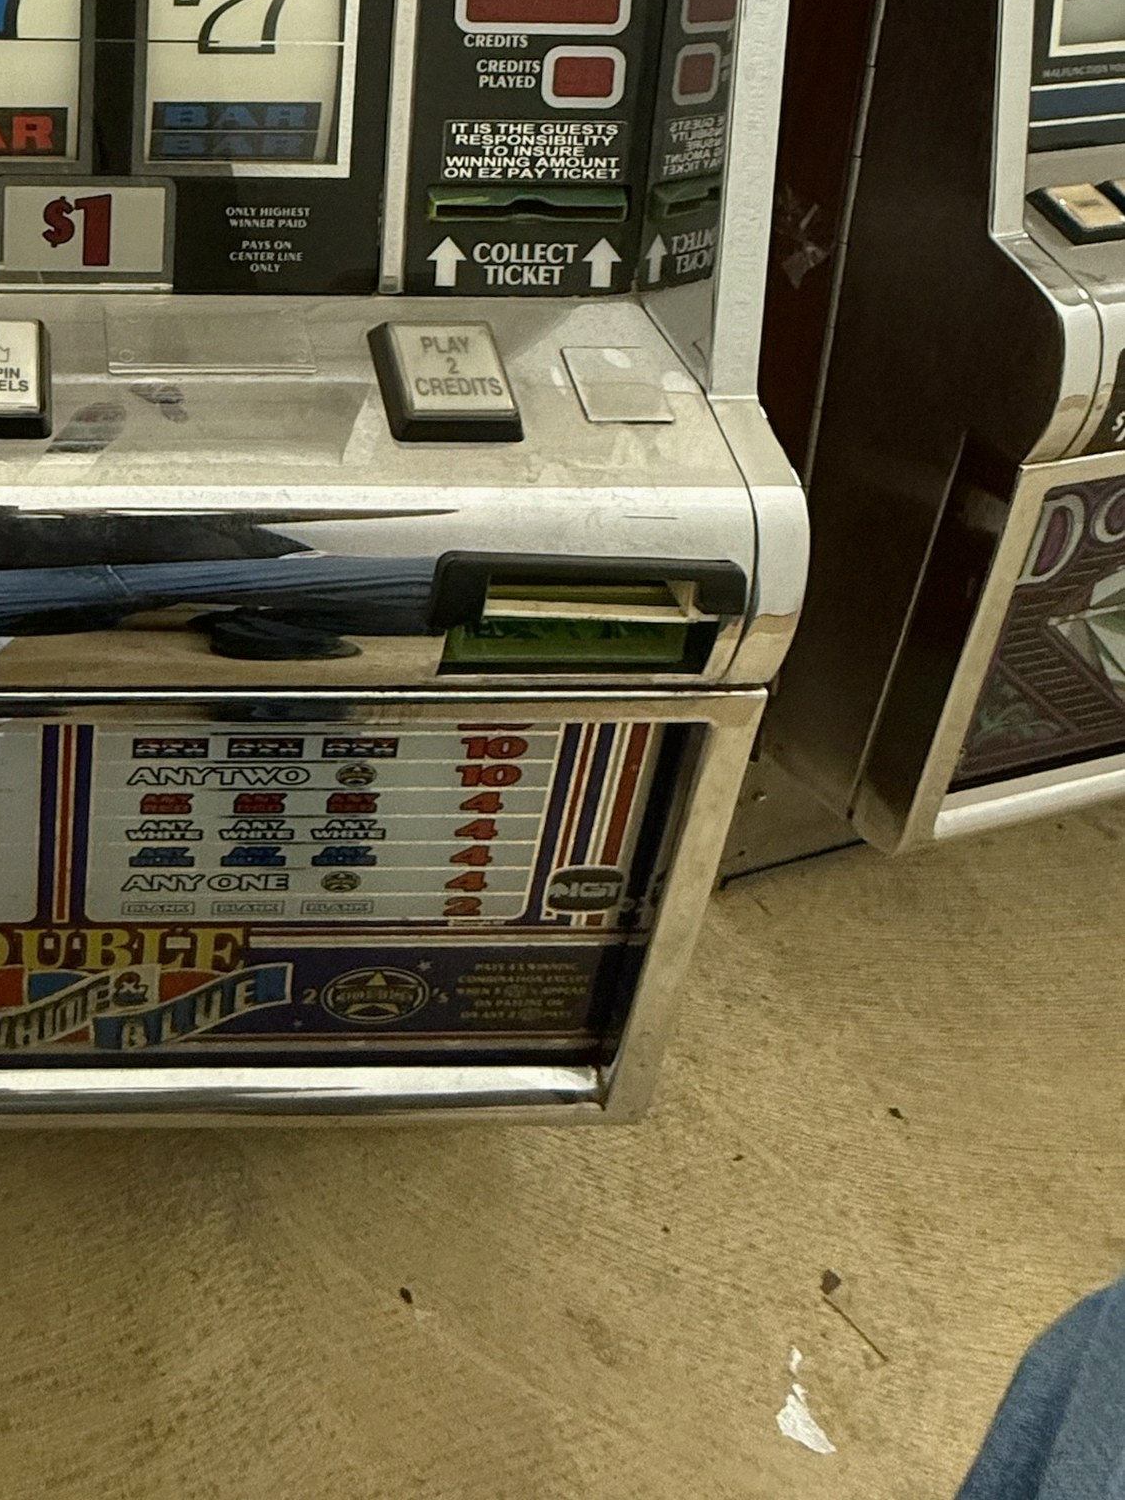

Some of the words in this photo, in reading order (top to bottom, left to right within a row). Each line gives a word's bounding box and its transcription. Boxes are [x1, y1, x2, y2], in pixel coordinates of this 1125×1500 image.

[463, 34, 529, 48] CREDITS
[476, 60, 541, 73] CREDITS
[479, 75, 536, 89] PLAYED
[162, 104, 309, 127] BAR
[451, 123, 468, 134] IT
[474, 123, 492, 134] IS
[497, 123, 535, 135] THE
[539, 124, 619, 135] GUESTS
[159, 134, 305, 156] BAR
[455, 134, 615, 146] RESPONSIBILITY
[482, 145, 508, 156] TO
[513, 146, 585, 157] INSURE
[446, 156, 531, 168] WINNING
[535, 157, 619, 168] AMOUNT
[444, 167, 472, 179] ON
[478, 168, 502, 179] EZ
[507, 168, 547, 179] PAY
[551, 168, 621, 180] TICKET
[226, 207, 257, 218] ONLY
[259, 207, 311, 218] HIGHEST
[42, 194, 113, 266] $1
[229, 218, 275, 229] WINNER
[277, 219, 308, 230] PAID
[241, 240, 272, 251] PAYS
[274, 240, 292, 251] ON
[472, 243, 579, 264] COLLECT
[229, 251, 275, 262] CENTER
[278, 251, 304, 262] LINE
[249, 263, 281, 274] ONLY
[483, 265, 566, 285] TICKET
[420, 336, 469, 353] PLAY
[446, 357, 459, 374] 2
[415, 377, 503, 396] CREDITS
[461, 735, 528, 760] 10
[127, 766, 216, 787] ANY
[212, 766, 311, 787] TWO
[455, 763, 522, 788] 10
[460, 791, 504, 813] 4
[454, 819, 498, 840] 4
[449, 845, 493, 867] 4
[121, 873, 205, 892] ANY
[208, 873, 289, 892] ONE
[445, 871, 488, 892] 4
[442, 896, 484, 916] 2
[115, 971, 148, 1006] &
[121, 980, 257, 1052] BLUE
